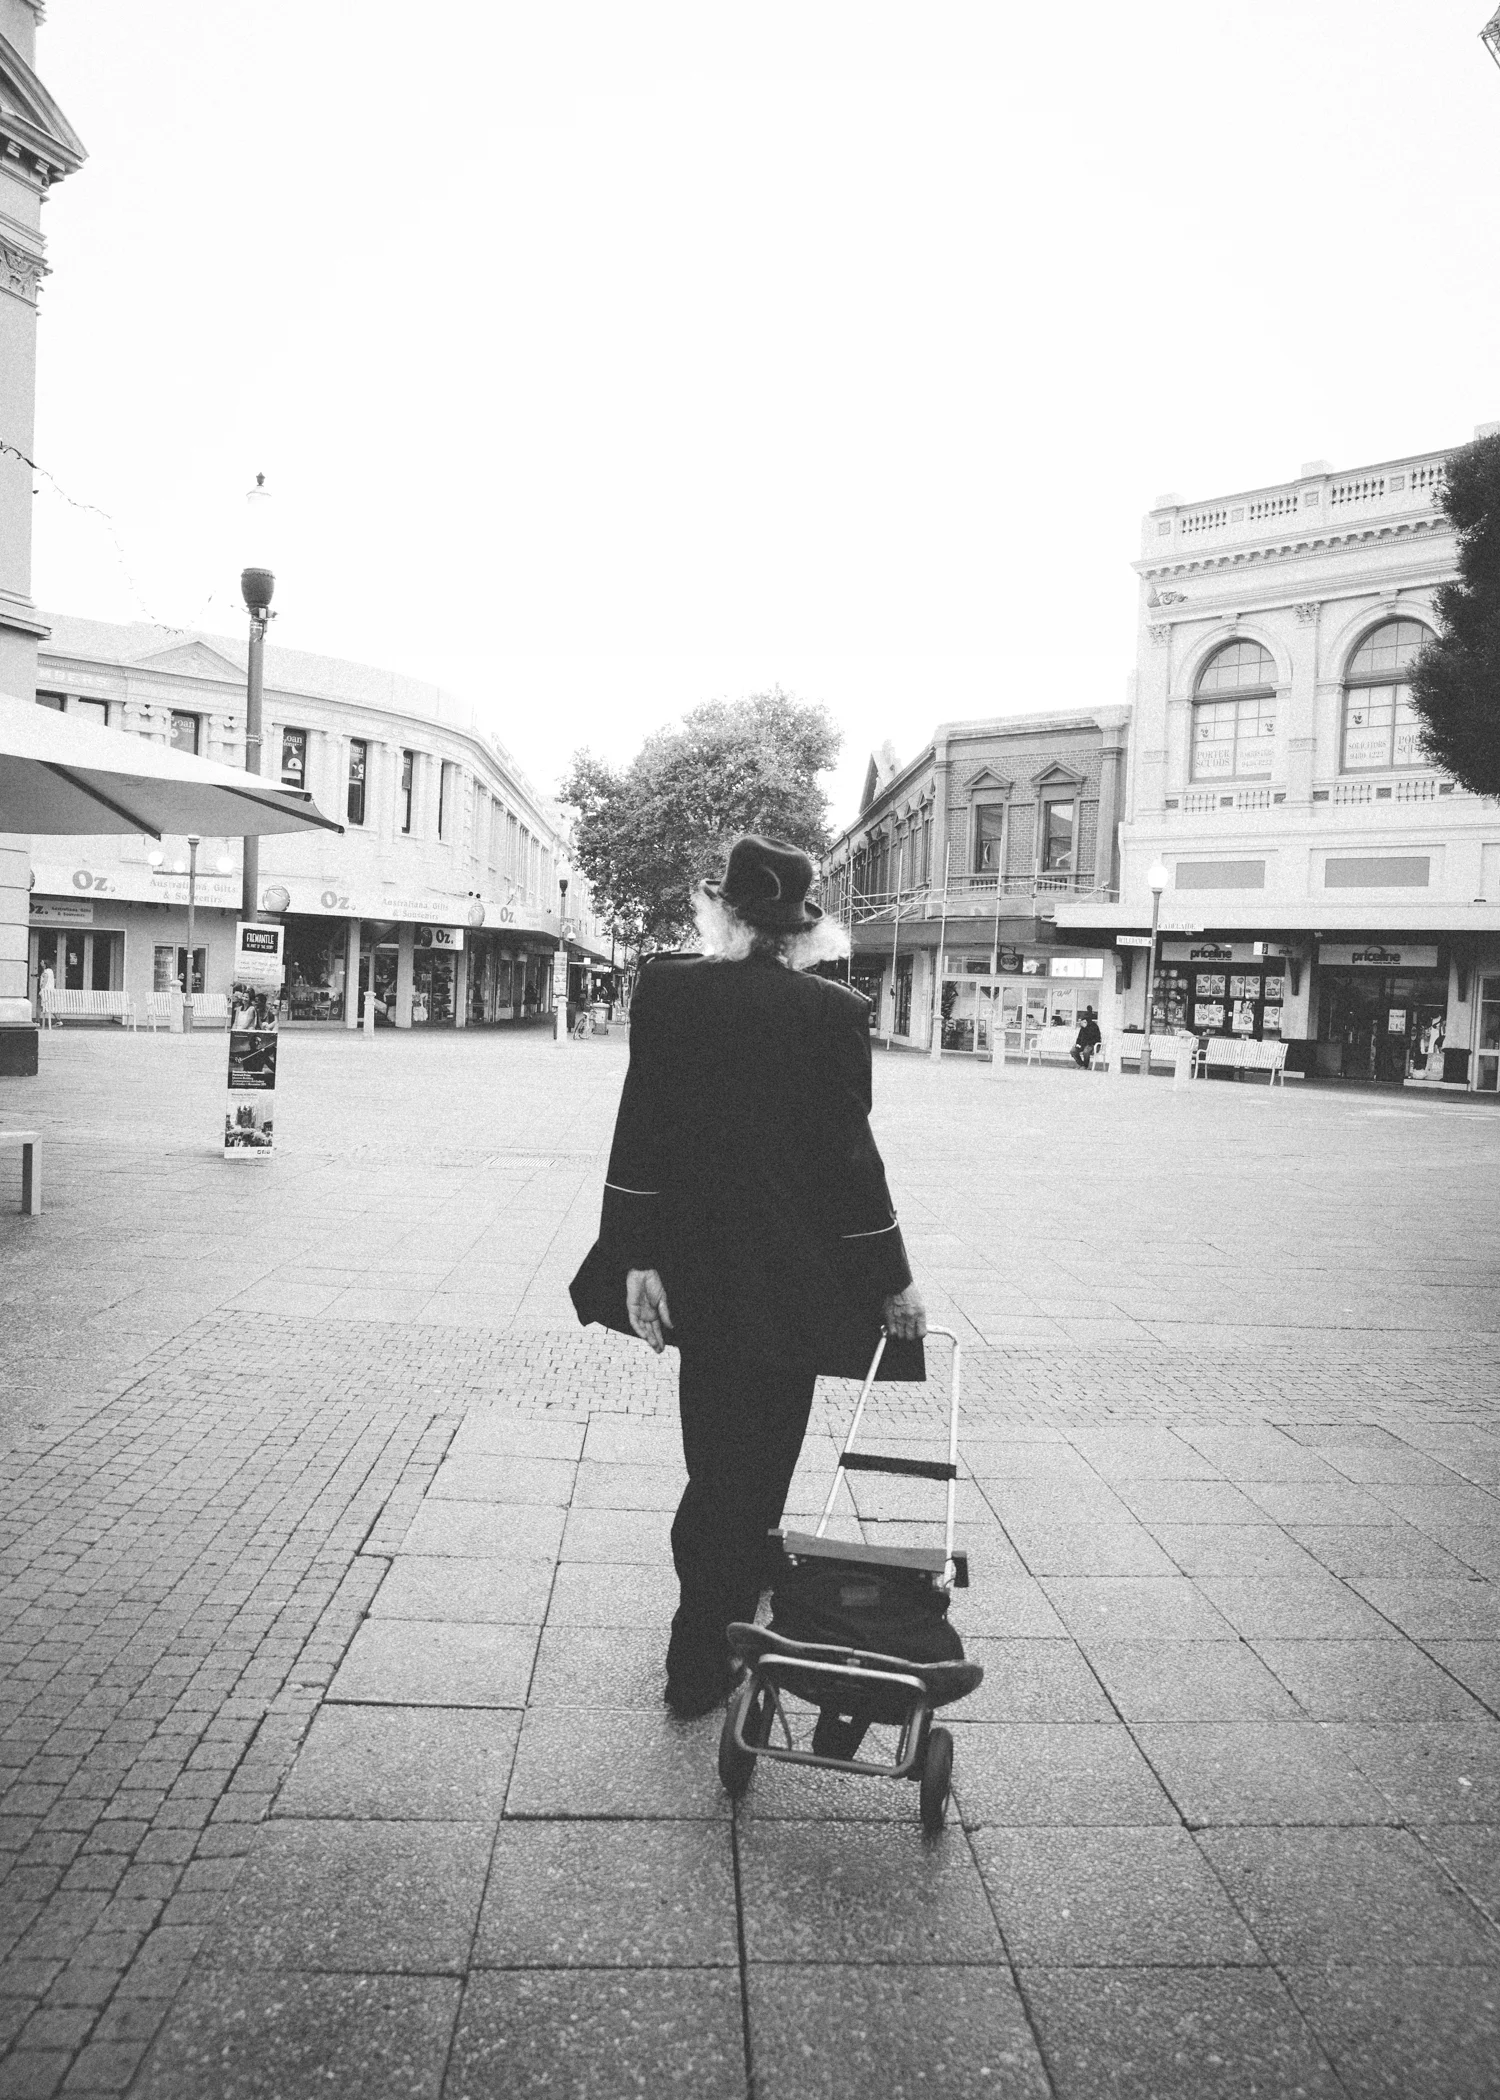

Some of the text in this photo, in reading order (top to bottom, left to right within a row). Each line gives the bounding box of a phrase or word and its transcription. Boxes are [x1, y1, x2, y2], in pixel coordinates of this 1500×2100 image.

[1197, 749, 1230, 760] PORTER
[1196, 758, 1230, 769] SCUDDS
[214, 883, 237, 893] Gifts
[175, 892, 223, 904] Sovenirs
[246, 932, 275, 945] FREMANTLE
[1118, 937, 1143, 945] WILLIAM
[1190, 948, 1233, 961] priceline
[1352, 950, 1402, 964] priceline
